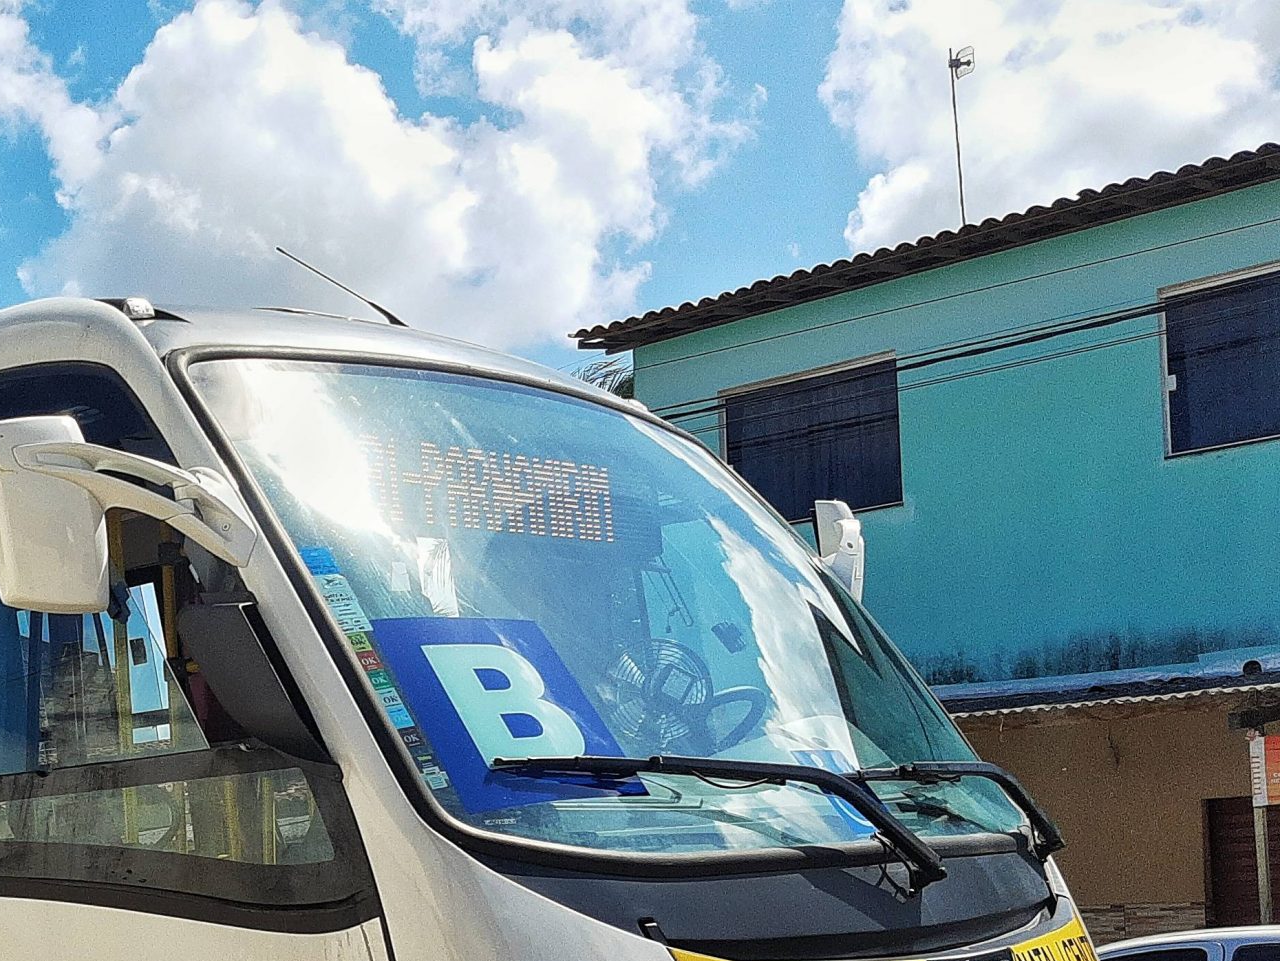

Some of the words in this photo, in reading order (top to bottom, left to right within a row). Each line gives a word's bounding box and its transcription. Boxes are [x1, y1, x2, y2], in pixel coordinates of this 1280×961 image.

[361, 656, 378, 666] OK
[371, 676, 388, 685] OK
[383, 695, 399, 704] OK
[422, 644, 586, 770] B
[403, 734, 420, 743] OK
